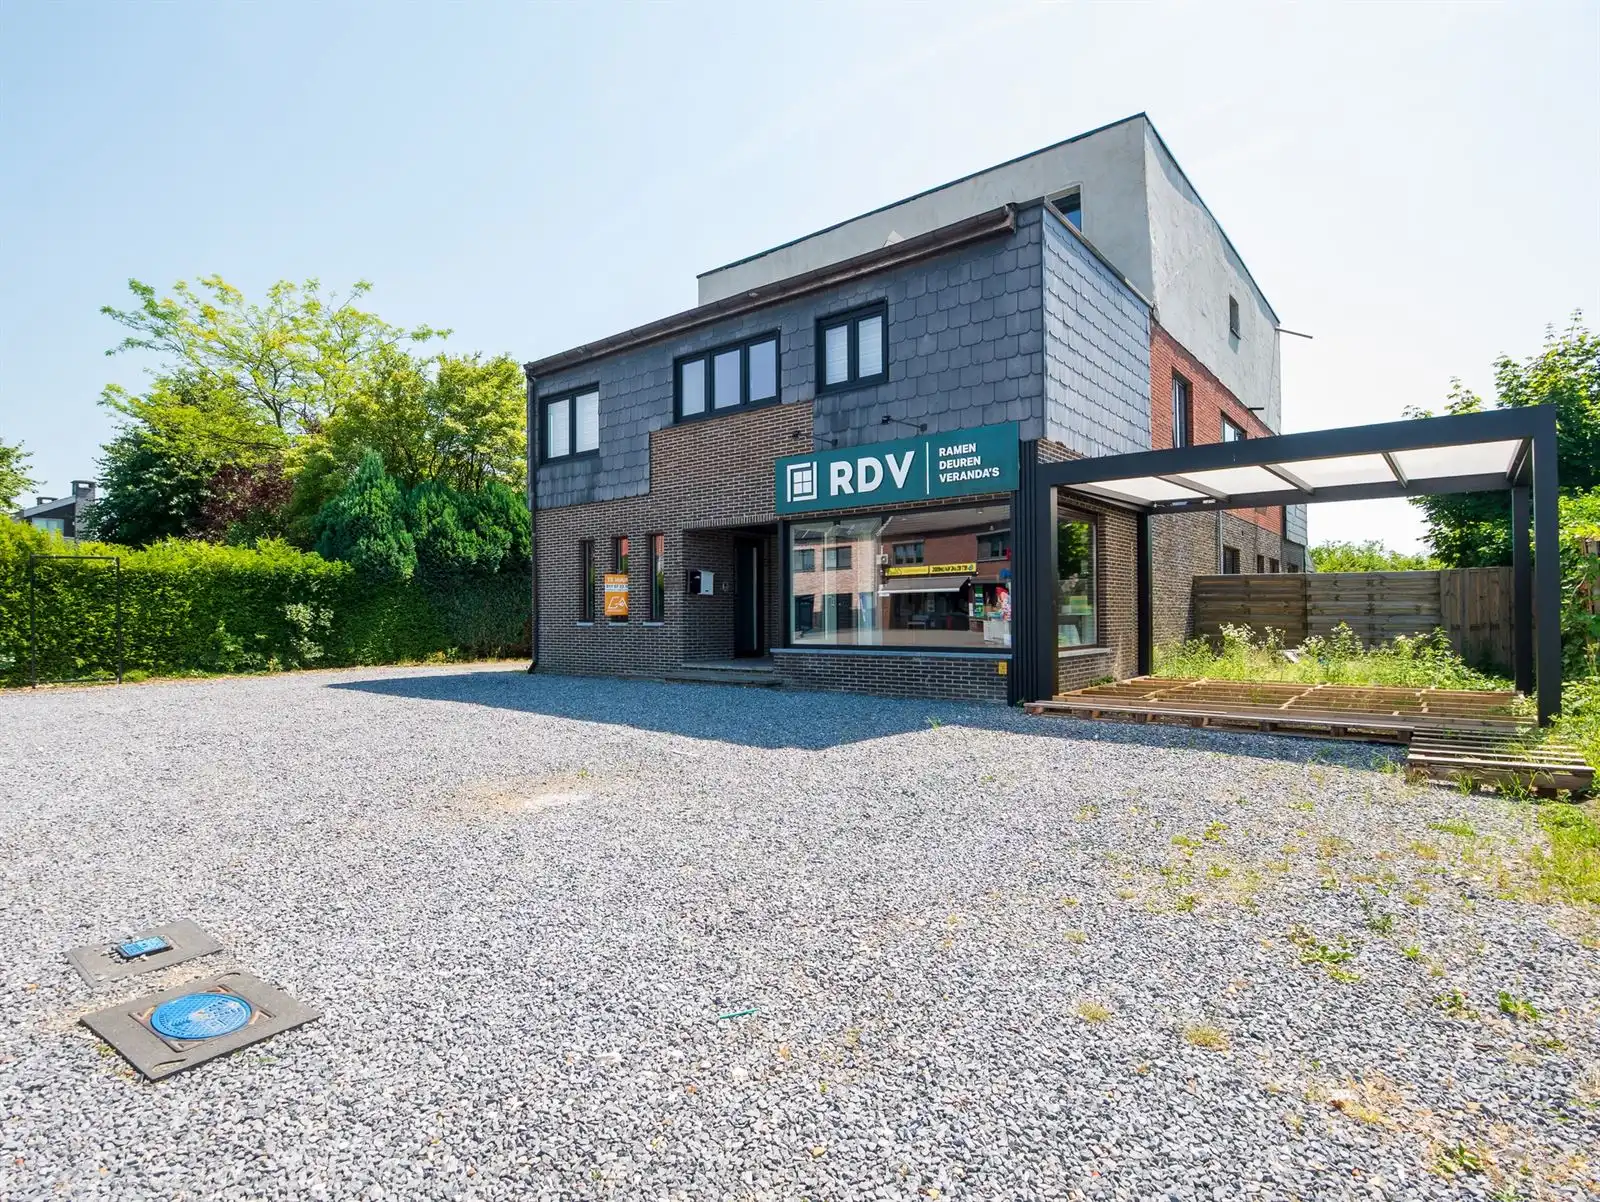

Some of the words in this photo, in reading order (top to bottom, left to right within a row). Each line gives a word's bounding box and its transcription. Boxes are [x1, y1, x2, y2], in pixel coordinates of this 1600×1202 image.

[938, 442, 977, 457] RAMEN
[938, 456, 981, 470] DEUREN
[830, 451, 915, 497] RDV
[938, 467, 1000, 483] VERANDA'S
